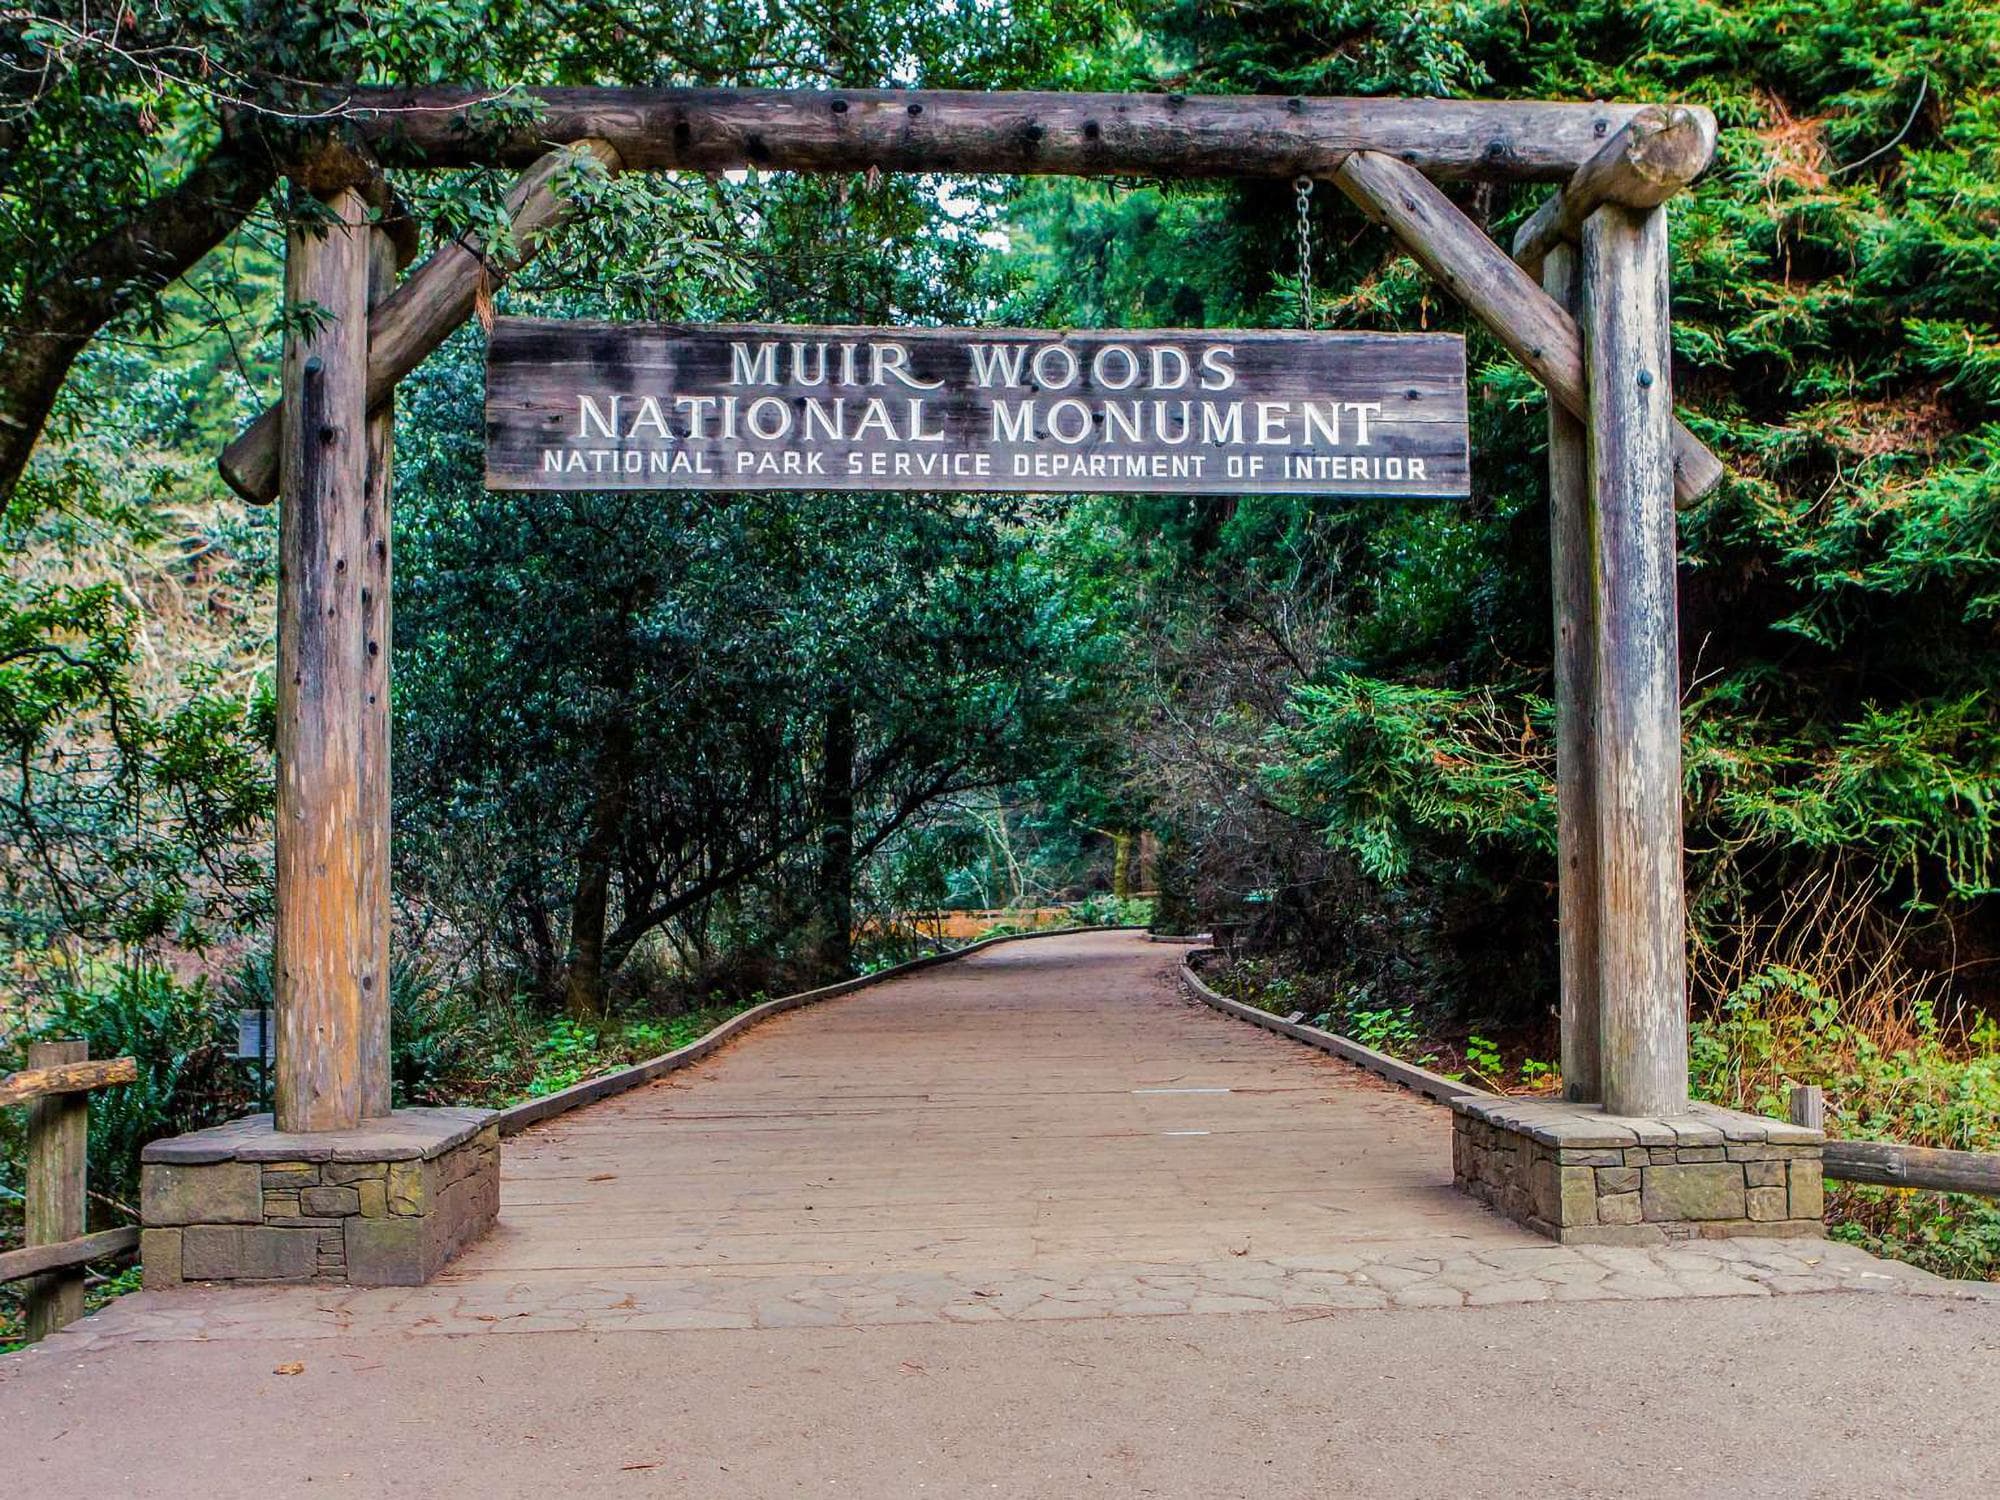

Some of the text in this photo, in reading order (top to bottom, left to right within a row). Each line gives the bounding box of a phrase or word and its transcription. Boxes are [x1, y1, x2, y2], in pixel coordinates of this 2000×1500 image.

[729, 341, 1237, 391] MUIR WOODS
[575, 394, 1382, 447] NATIONAL MONUMENT
[543, 449, 1428, 482] NATIONAL PARK SERVICE DEPARTMENT OF INTERIOR
